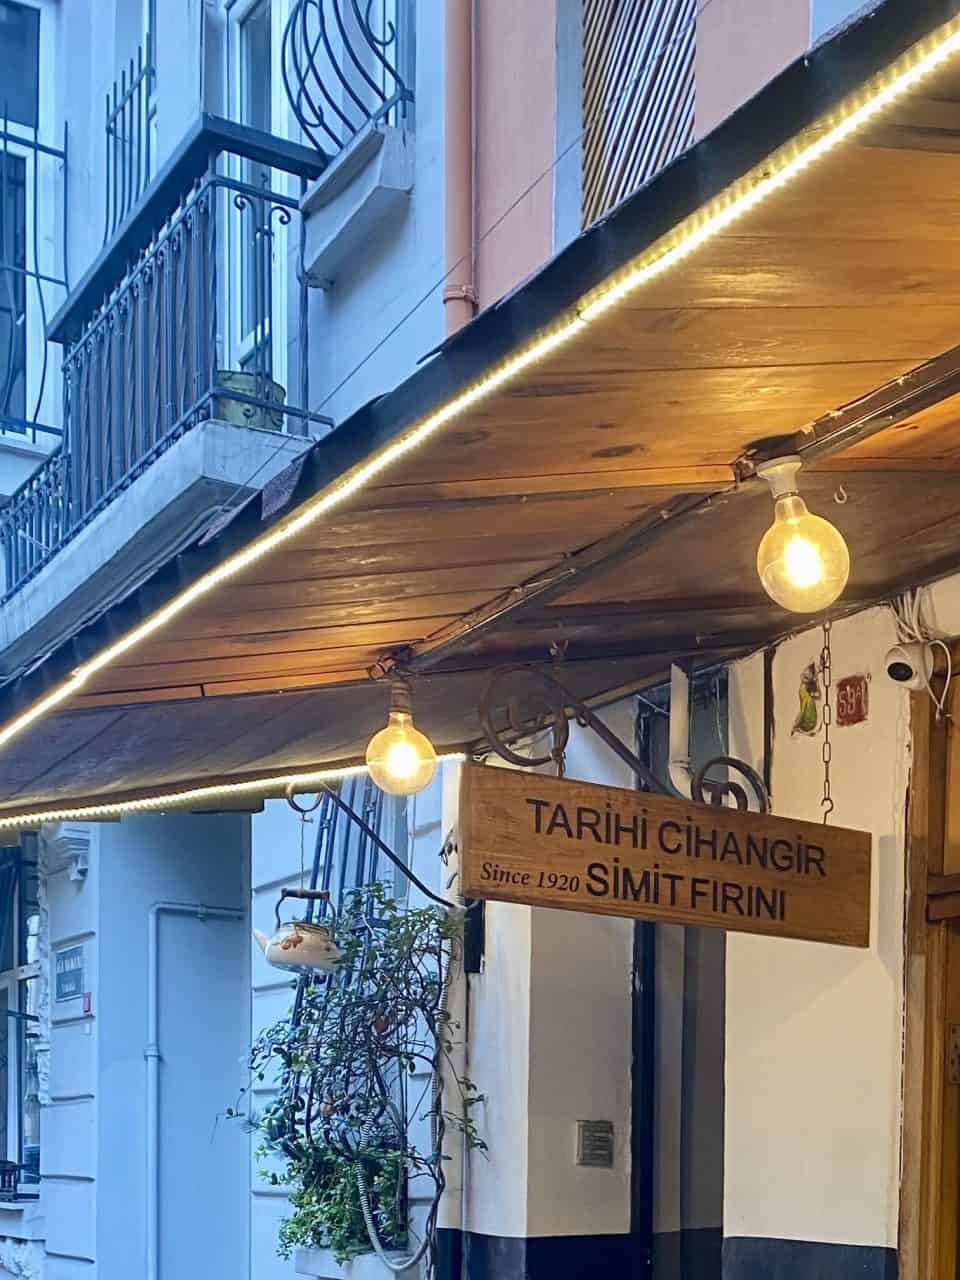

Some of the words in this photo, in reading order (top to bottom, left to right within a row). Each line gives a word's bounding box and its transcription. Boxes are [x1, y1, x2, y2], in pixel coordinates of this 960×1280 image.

[525, 798, 647, 850] TARİHİ
[658, 816, 826, 877] CİHANGİR
[481, 861, 530, 886] Since
[536, 871, 580, 893] 1920
[586, 857, 684, 906] SİMİT
[691, 877, 786, 921] FIRINI
